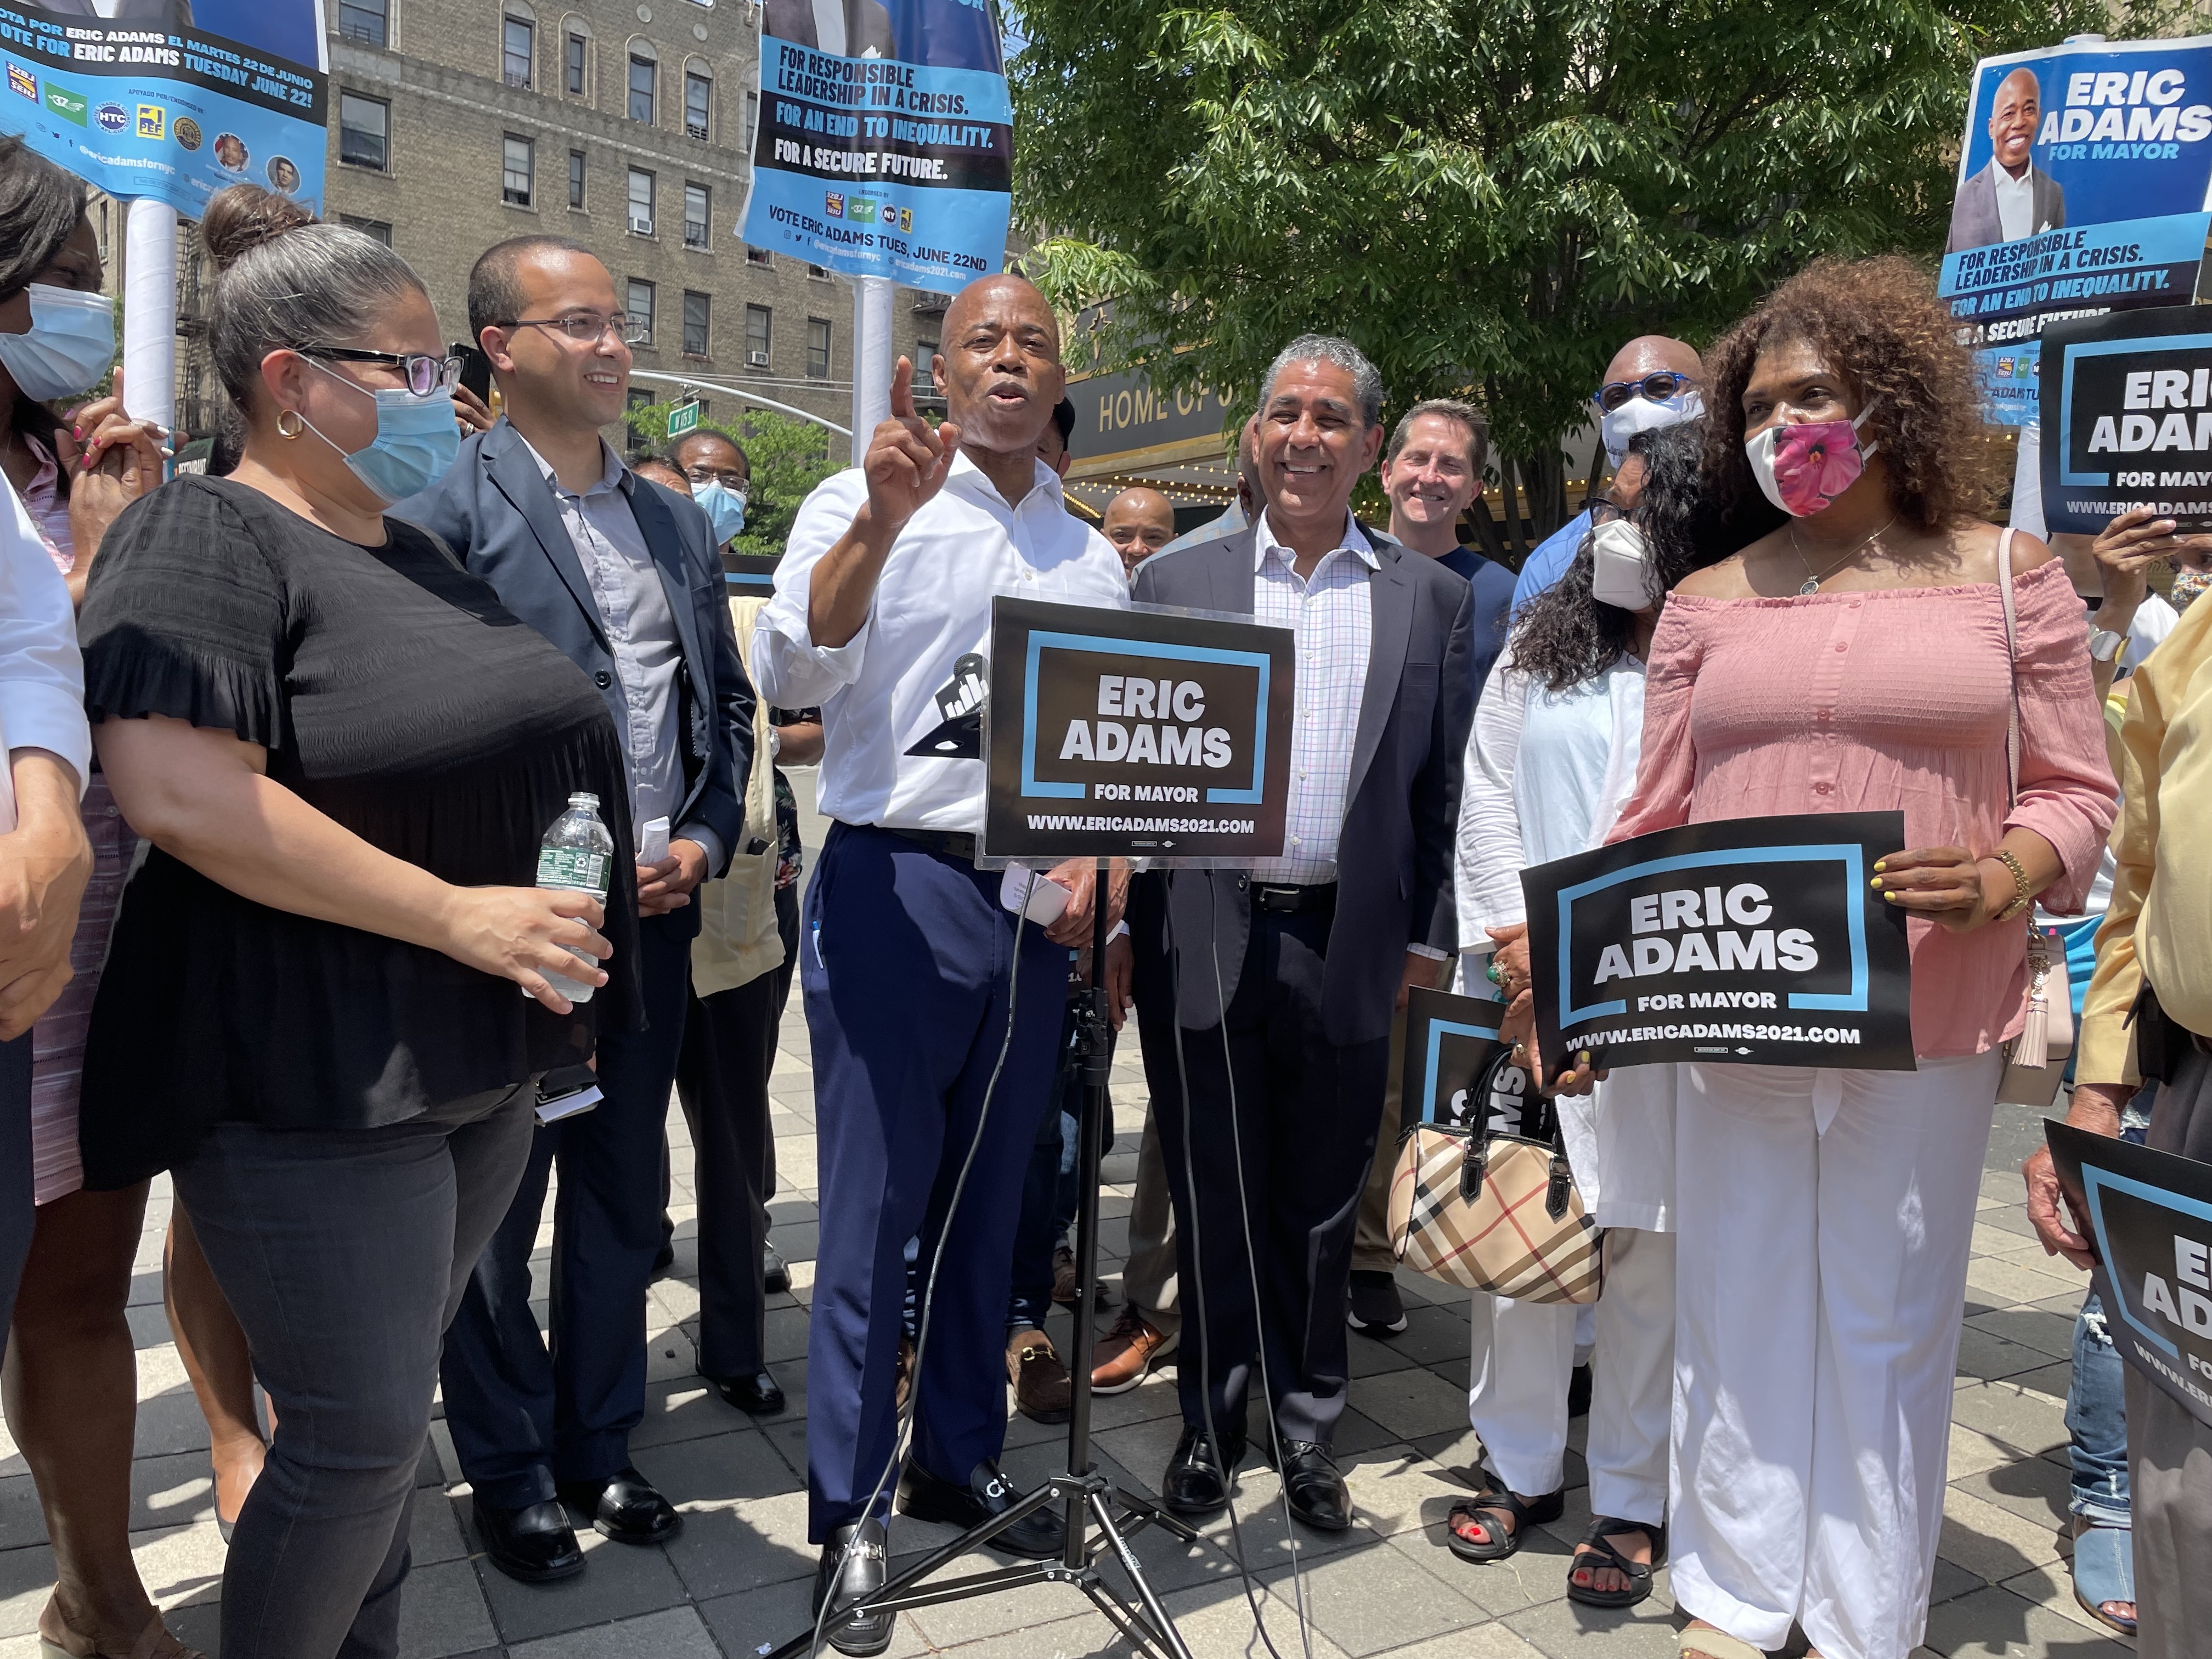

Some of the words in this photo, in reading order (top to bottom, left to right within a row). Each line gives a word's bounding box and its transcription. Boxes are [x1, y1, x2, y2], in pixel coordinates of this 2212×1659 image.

[0, 8, 26, 26] OTA
[29, 18, 63, 37] POR
[66, 27, 103, 42] ERIC
[106, 31, 165, 44] ADAMS
[168, 35, 183, 47] EL
[187, 39, 240, 64] MARTES
[243, 58, 258, 71] 22
[259, 63, 275, 76] DE
[275, 69, 313, 89] JUNIO
[0, 21, 33, 48] OTE
[37, 35, 70, 58] FOR
[74, 43, 115, 62] ERIC
[118, 46, 180, 66] ADAMS
[184, 53, 248, 87] TUESDAY
[251, 76, 287, 100] JUNE
[290, 88, 312, 108] 22!
[780, 45, 805, 71] FOR
[809, 56, 915, 88] RESPONSIBLE
[7, 62, 35, 82] 32BJ
[10, 81, 36, 99] SEIU
[778, 68, 865, 105] LEADERSHIP
[871, 86, 890, 106] IN
[895, 89, 905, 108] A
[910, 92, 968, 115] CRISIS.
[2066, 68, 2186, 107] ERIC
[128, 89, 154, 97] APOYADO
[99, 112, 126, 123] HTC
[140, 122, 162, 133] PEF
[776, 101, 801, 128] FOR
[804, 109, 823, 131] AN
[826, 112, 859, 137] END
[864, 116, 888, 137] TO
[892, 120, 993, 149] INEQUALITY.
[2038, 104, 2212, 146] ADAMS
[80, 145, 175, 175] @ericadamsfornyc
[775, 138, 800, 163] FOR
[803, 145, 811, 167] A
[814, 147, 877, 174] SECURE
[881, 152, 948, 180] FUTURE.
[2049, 143, 2086, 161] FOR
[2092, 143, 2180, 160] MAYOR
[884, 210, 895, 220] NY
[769, 205, 799, 227] VOTE
[802, 216, 823, 236] ERIC
[826, 226, 873, 247] ADAMS
[877, 235, 910, 258] TUES,
[913, 246, 950, 264] JUNE
[953, 253, 988, 272] 22ND
[814, 240, 881, 262] @ericadamsfornyc
[1959, 252, 1985, 272] FOR
[1989, 230, 2087, 266] RESPONSIBLE
[895, 258, 966, 280] ericadams2021.com
[1955, 263, 2038, 290] LEADERSHIP
[2039, 255, 2053, 273] IN
[2057, 252, 2070, 270] A
[2077, 244, 2143, 268] CRISIS.
[1950, 298, 1978, 317] FOR
[1979, 293, 2002, 313] AN
[2005, 287, 2031, 309] END
[2032, 284, 2047, 303] TO
[2051, 269, 2170, 300] INEQUALITY.
[1987, 315, 2037, 342] SECURE
[2124, 368, 2212, 409] ERI
[1099, 386, 1168, 432] HOME
[2117, 471, 2155, 487] FOR
[2159, 471, 2212, 487] MAY
[1097, 674, 1206, 723] ERIC
[1059, 719, 1232, 769] ADAMS
[1094, 783, 1131, 801] FOR
[1135, 785, 1199, 803] MAYOR
[1027, 814, 1255, 834] WWW.ERICADAMS2021.COM
[1630, 882, 1773, 935] ERIC
[1593, 928, 1819, 986] ADAMS
[1637, 993, 1685, 1012] FOR
[1689, 991, 1778, 1009] MAYOR
[1565, 1023, 1861, 1053] WWW.ERICADAMS2021.COM
[2187, 1352, 2212, 1381] FO
